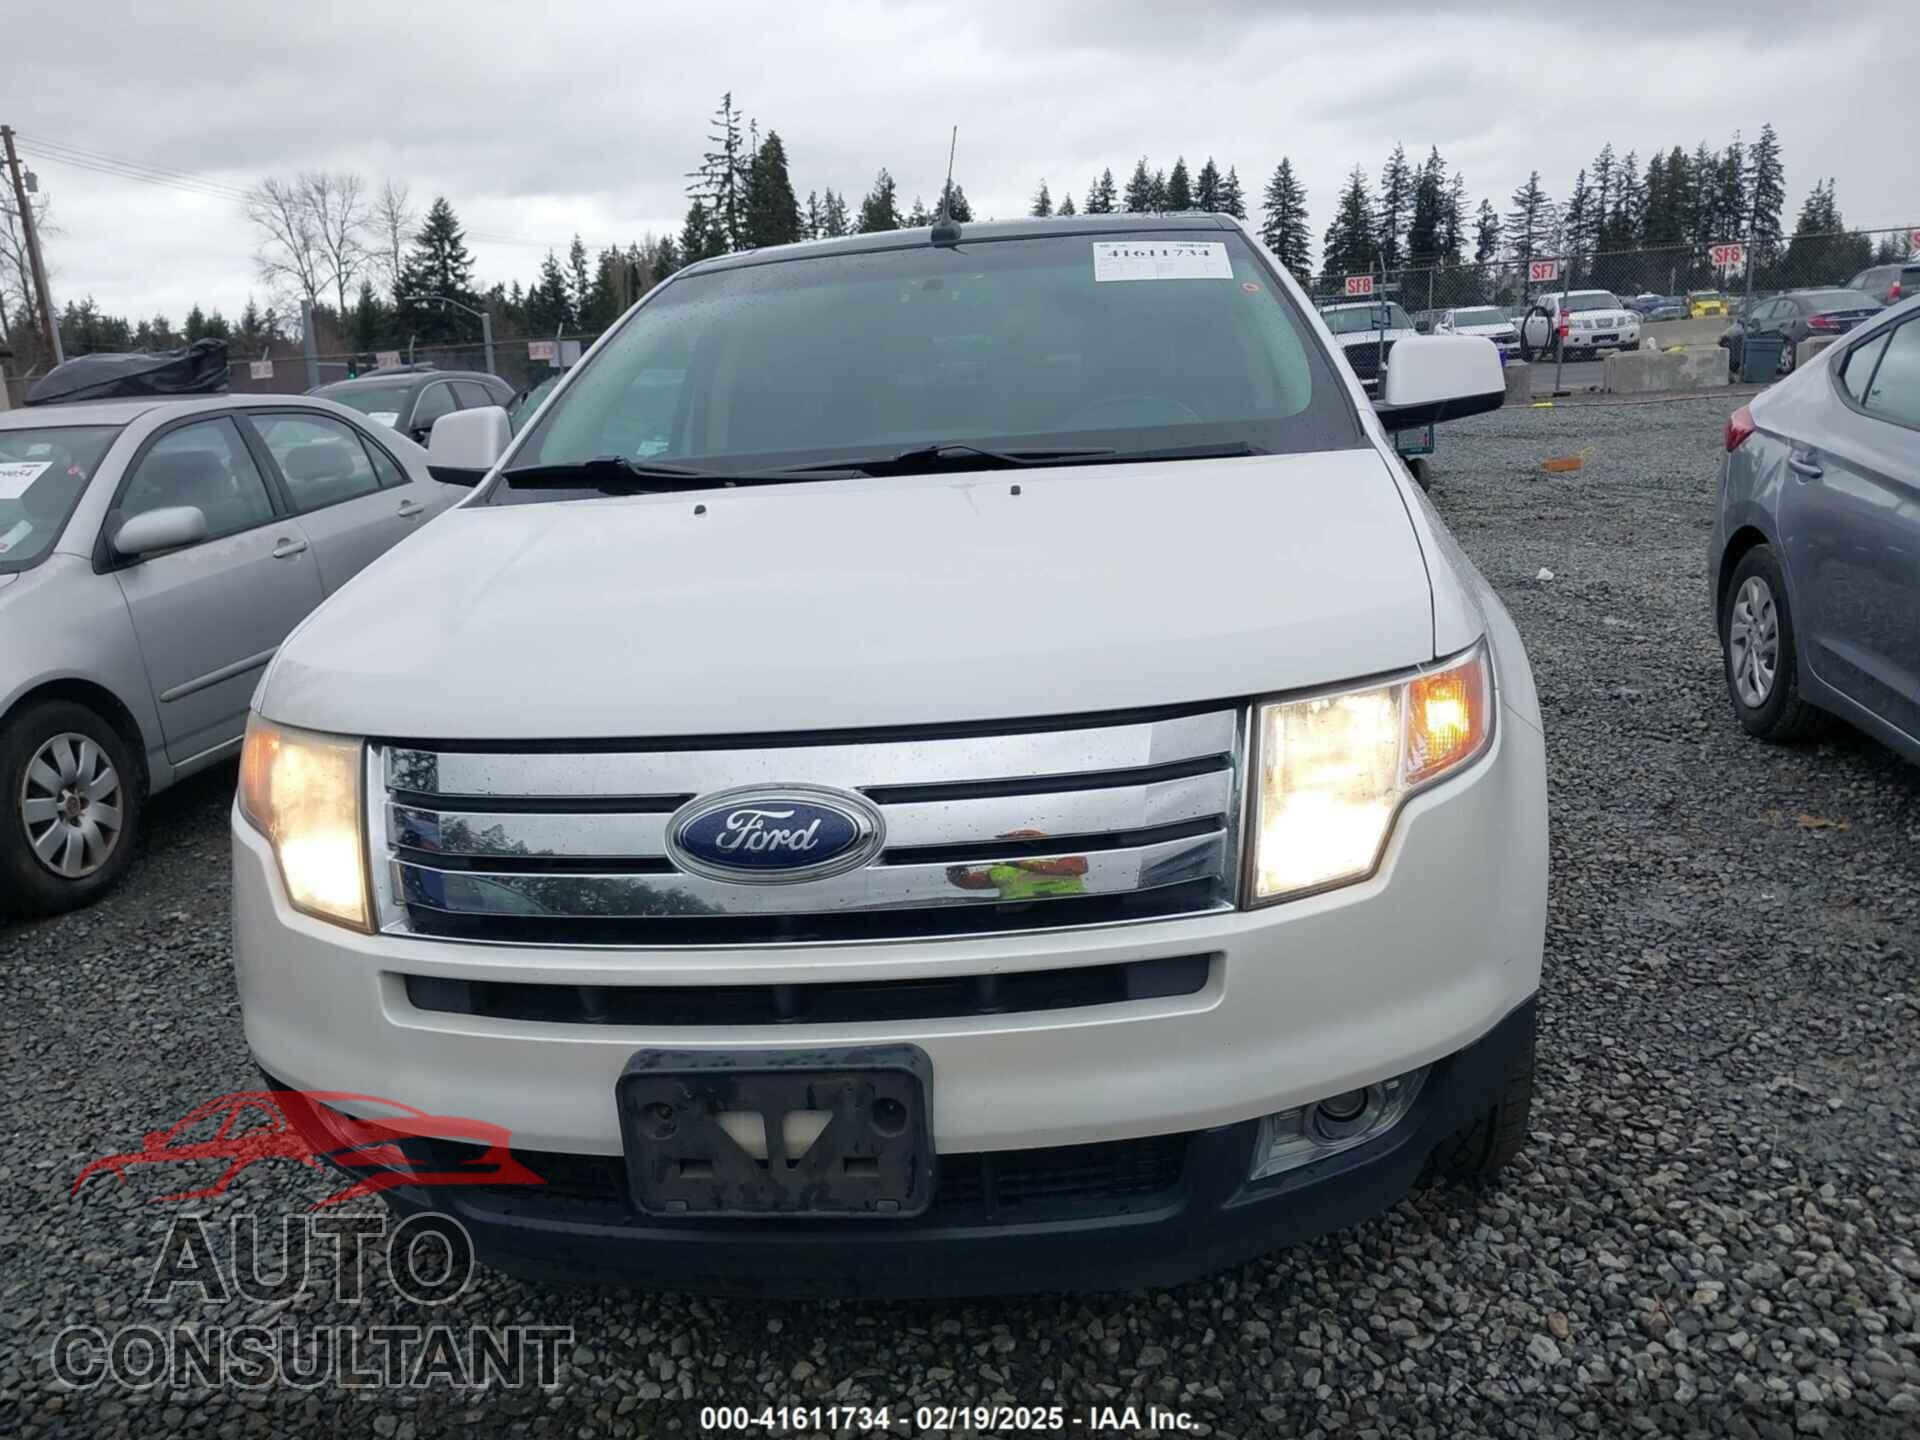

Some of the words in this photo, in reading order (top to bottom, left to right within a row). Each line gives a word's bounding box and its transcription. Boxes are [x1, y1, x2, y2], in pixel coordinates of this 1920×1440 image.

[1107, 248, 1211, 258] 41611734
[1714, 246, 1740, 263] SF6
[1532, 263, 1554, 279] SF7
[1348, 278, 1371, 294] SF8
[715, 810, 822, 851] Ford
